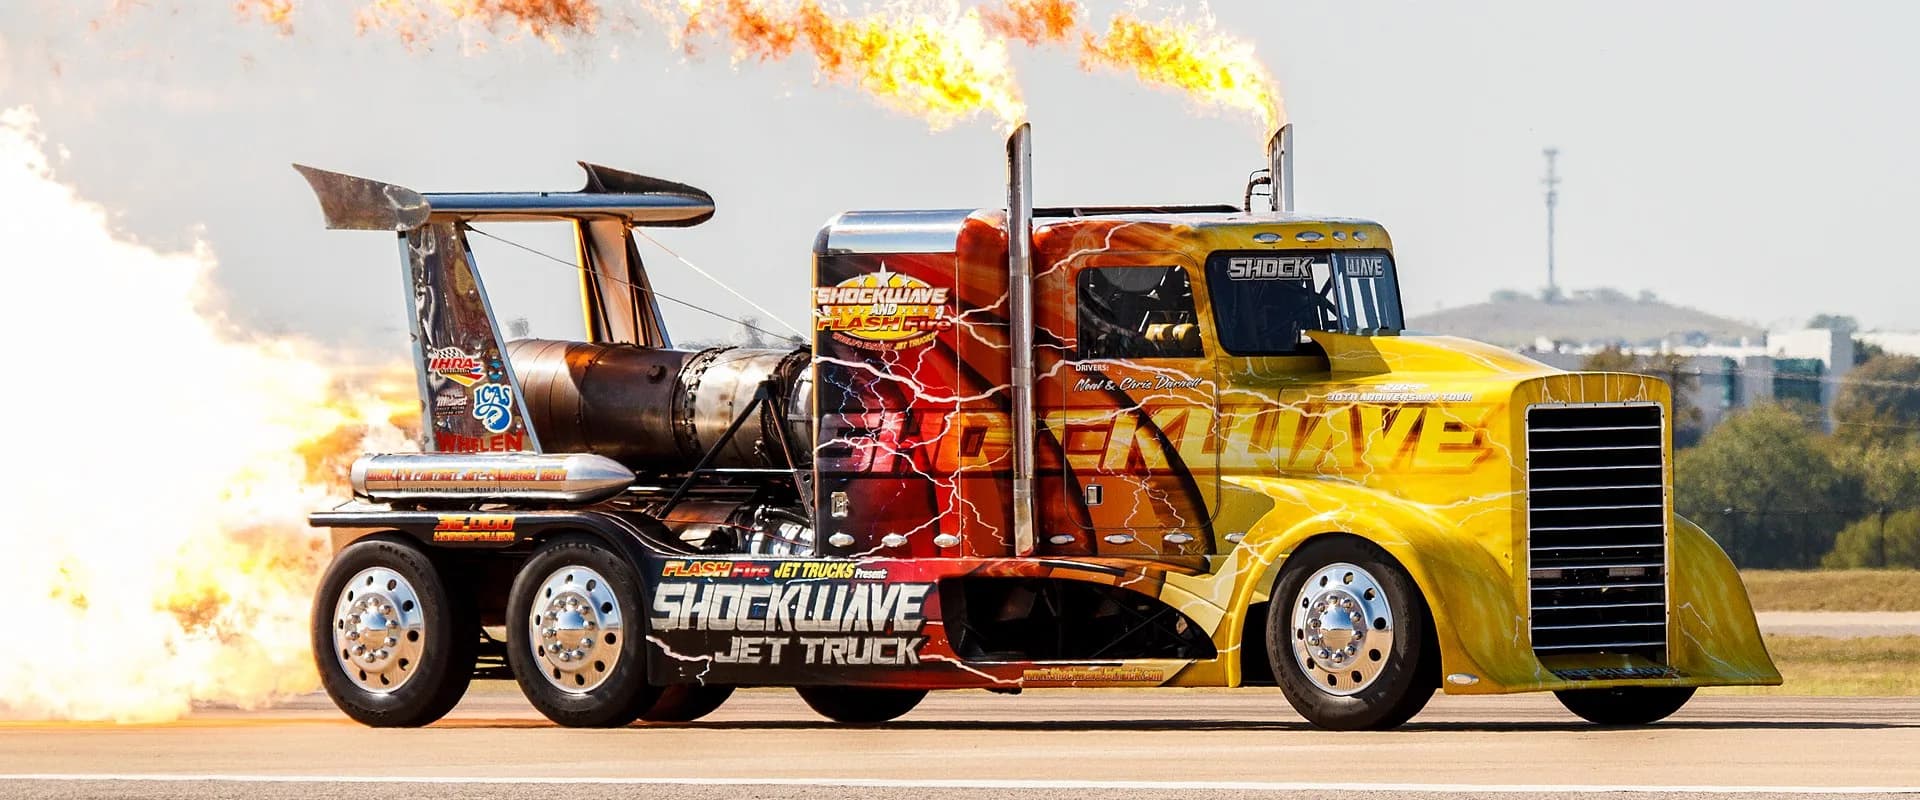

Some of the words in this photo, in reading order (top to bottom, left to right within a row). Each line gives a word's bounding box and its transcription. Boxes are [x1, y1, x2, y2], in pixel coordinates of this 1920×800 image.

[1228, 256, 1314, 281] SHOCK
[1345, 256, 1384, 278] WAVE
[817, 287, 951, 305] SHOCKWAVE
[871, 303, 898, 316] AND
[817, 316, 901, 331] FLASH
[430, 357, 474, 369] IHRA
[1075, 363, 1110, 372] DRIVERS:
[1074, 377, 1103, 392] Neal
[1104, 380, 1116, 391] &
[1120, 376, 1152, 391] Chris
[1155, 374, 1202, 391] Darnell
[474, 385, 510, 406] ICAS
[1359, 392, 1438, 402] ANNIVERSARY
[1441, 392, 1472, 402] TOUR
[436, 429, 523, 452] WHELEN
[815, 404, 1492, 474] SHOCKWAVE
[433, 531, 515, 541] HORSEPOWER
[662, 560, 732, 578] FLASH
[731, 562, 770, 577] Fire
[773, 561, 803, 579] JET
[802, 561, 856, 579] TRUCKS
[650, 582, 932, 632] SHOCKWAVE
[713, 636, 790, 665] JET
[798, 636, 926, 665] TRUCK
